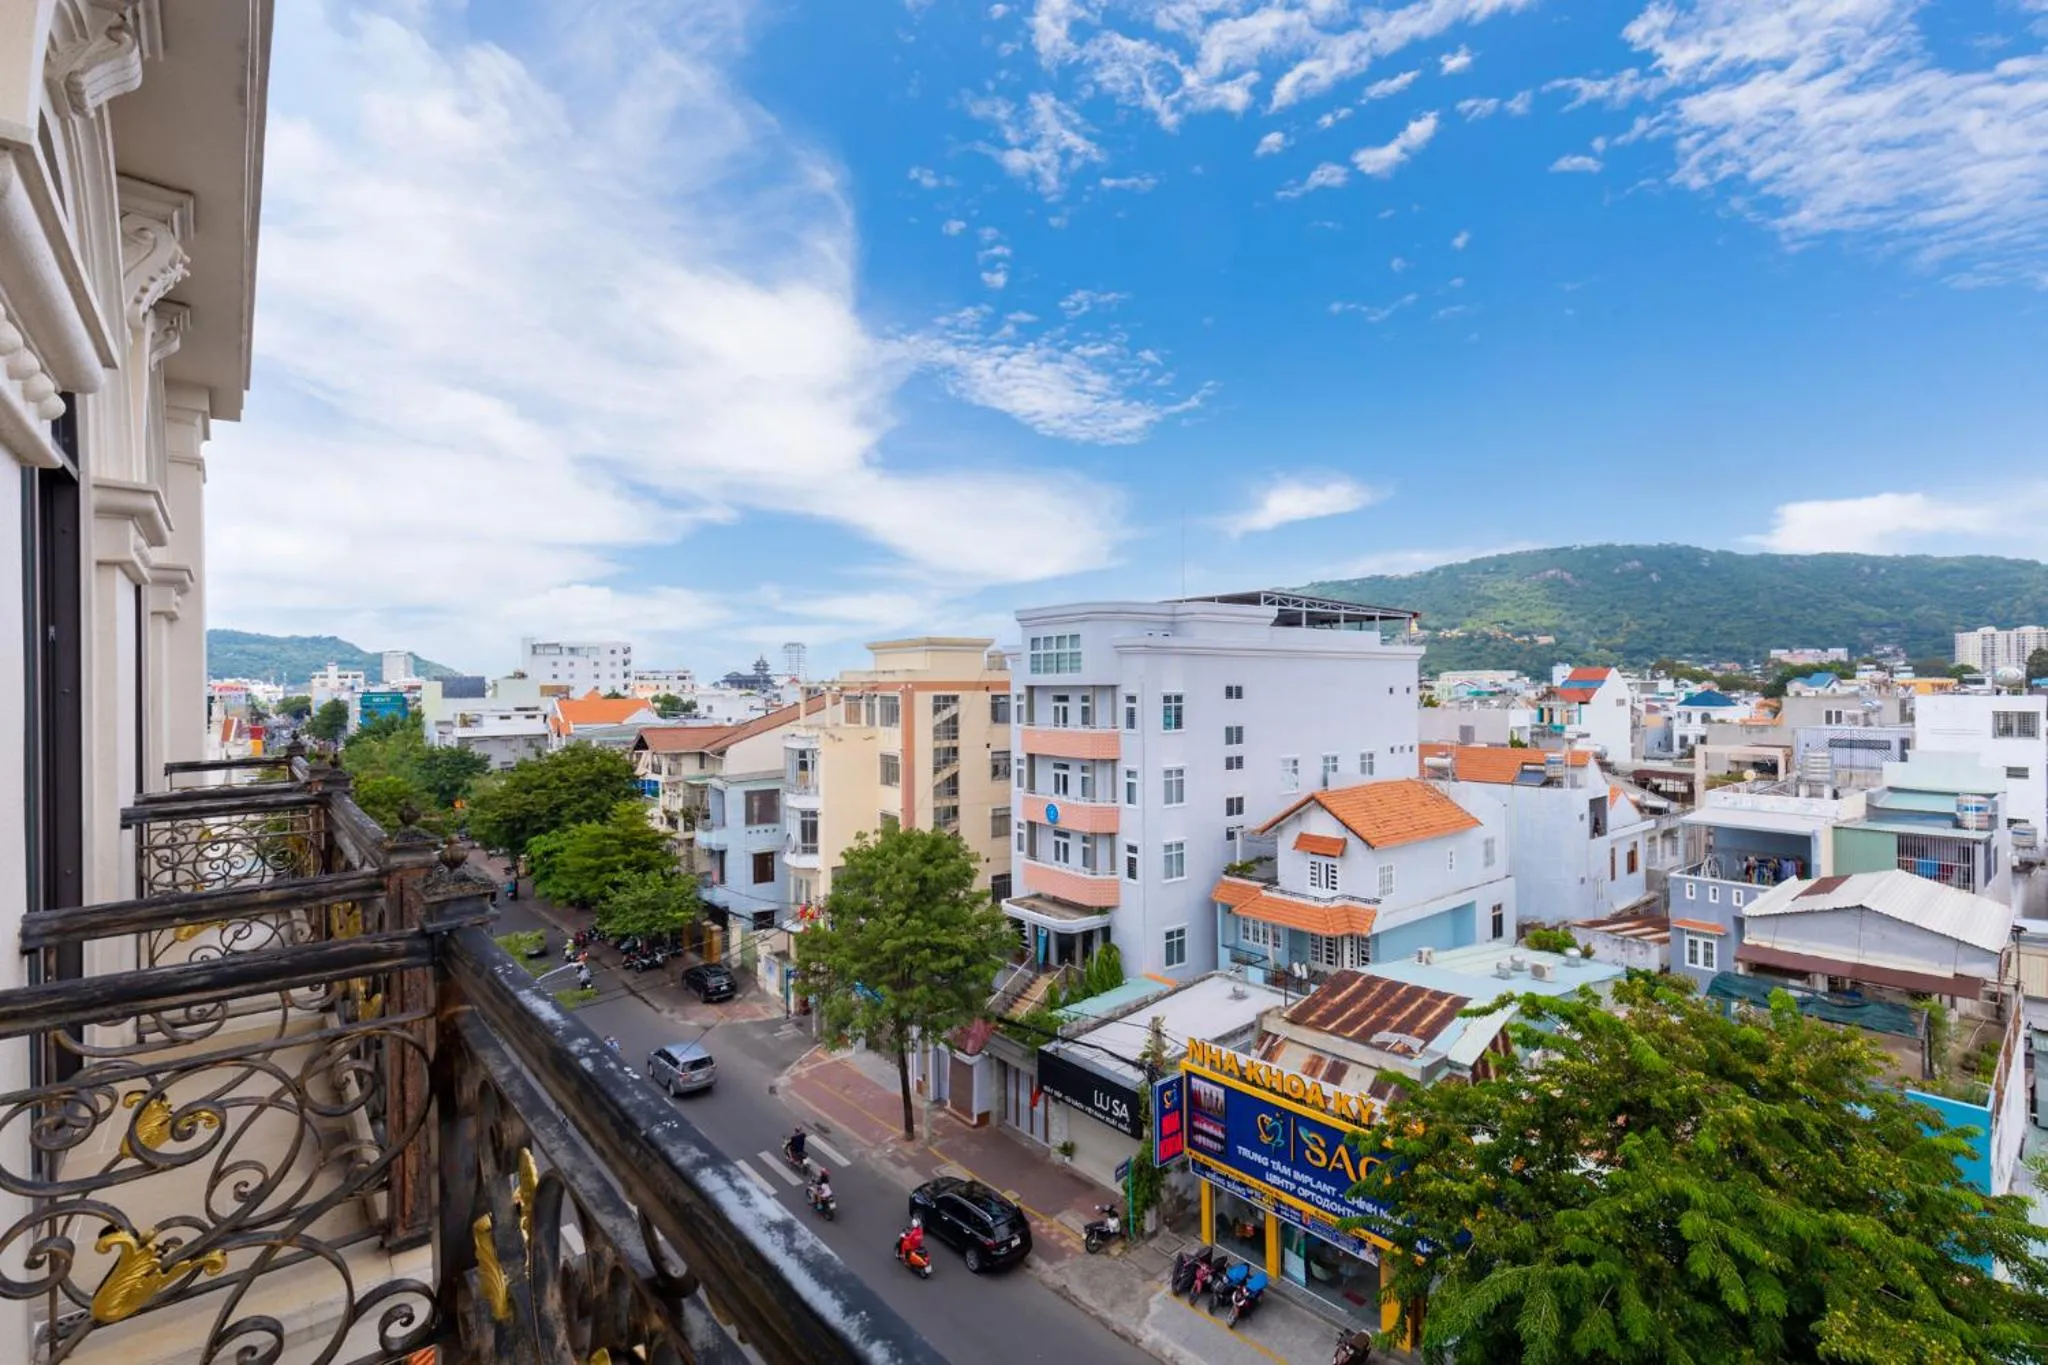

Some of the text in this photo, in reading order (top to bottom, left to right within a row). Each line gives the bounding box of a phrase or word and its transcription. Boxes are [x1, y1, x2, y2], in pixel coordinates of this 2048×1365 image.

[1187, 1037, 1241, 1077] NHA
[1245, 1060, 1327, 1110] KHOA
[1236, 1145, 1269, 1168] TRUNG
[1270, 1159, 1292, 1178] TÂM
[1292, 1170, 1337, 1196] IMPLANT
